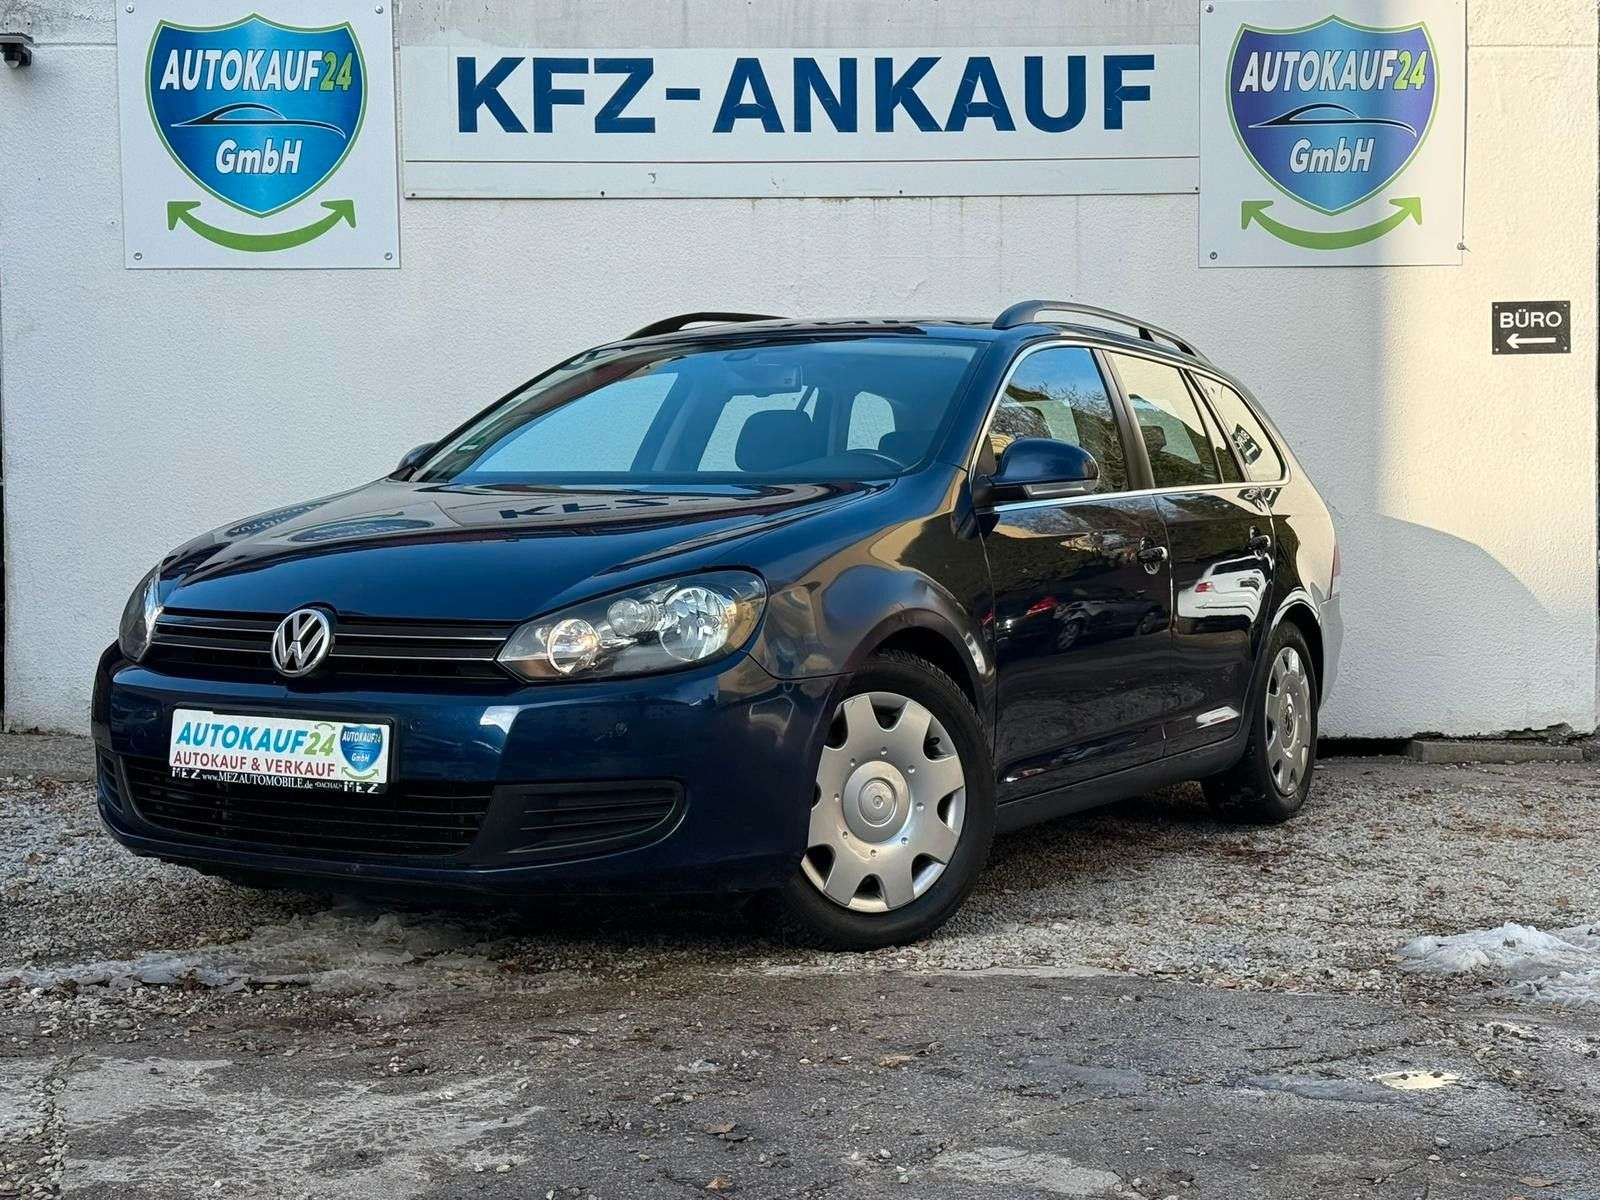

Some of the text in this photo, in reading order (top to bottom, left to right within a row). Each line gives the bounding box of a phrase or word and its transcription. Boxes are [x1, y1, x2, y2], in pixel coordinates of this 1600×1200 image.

[160, 48, 353, 92] AUTOKAUF24
[1238, 49, 1428, 92] AUTOKAUF24
[456, 54, 1155, 134] KFZ-ANKAUF
[215, 138, 302, 175] GmbH
[1289, 138, 1376, 174] GmbH
[1499, 308, 1563, 329] BÜRO
[176, 722, 336, 756] AUTOKAUF24
[341, 731, 382, 743] AUTOKAUF24
[173, 751, 336, 778] AUTOKAUF & VERKAUF
[351, 752, 370, 762] GmbH
